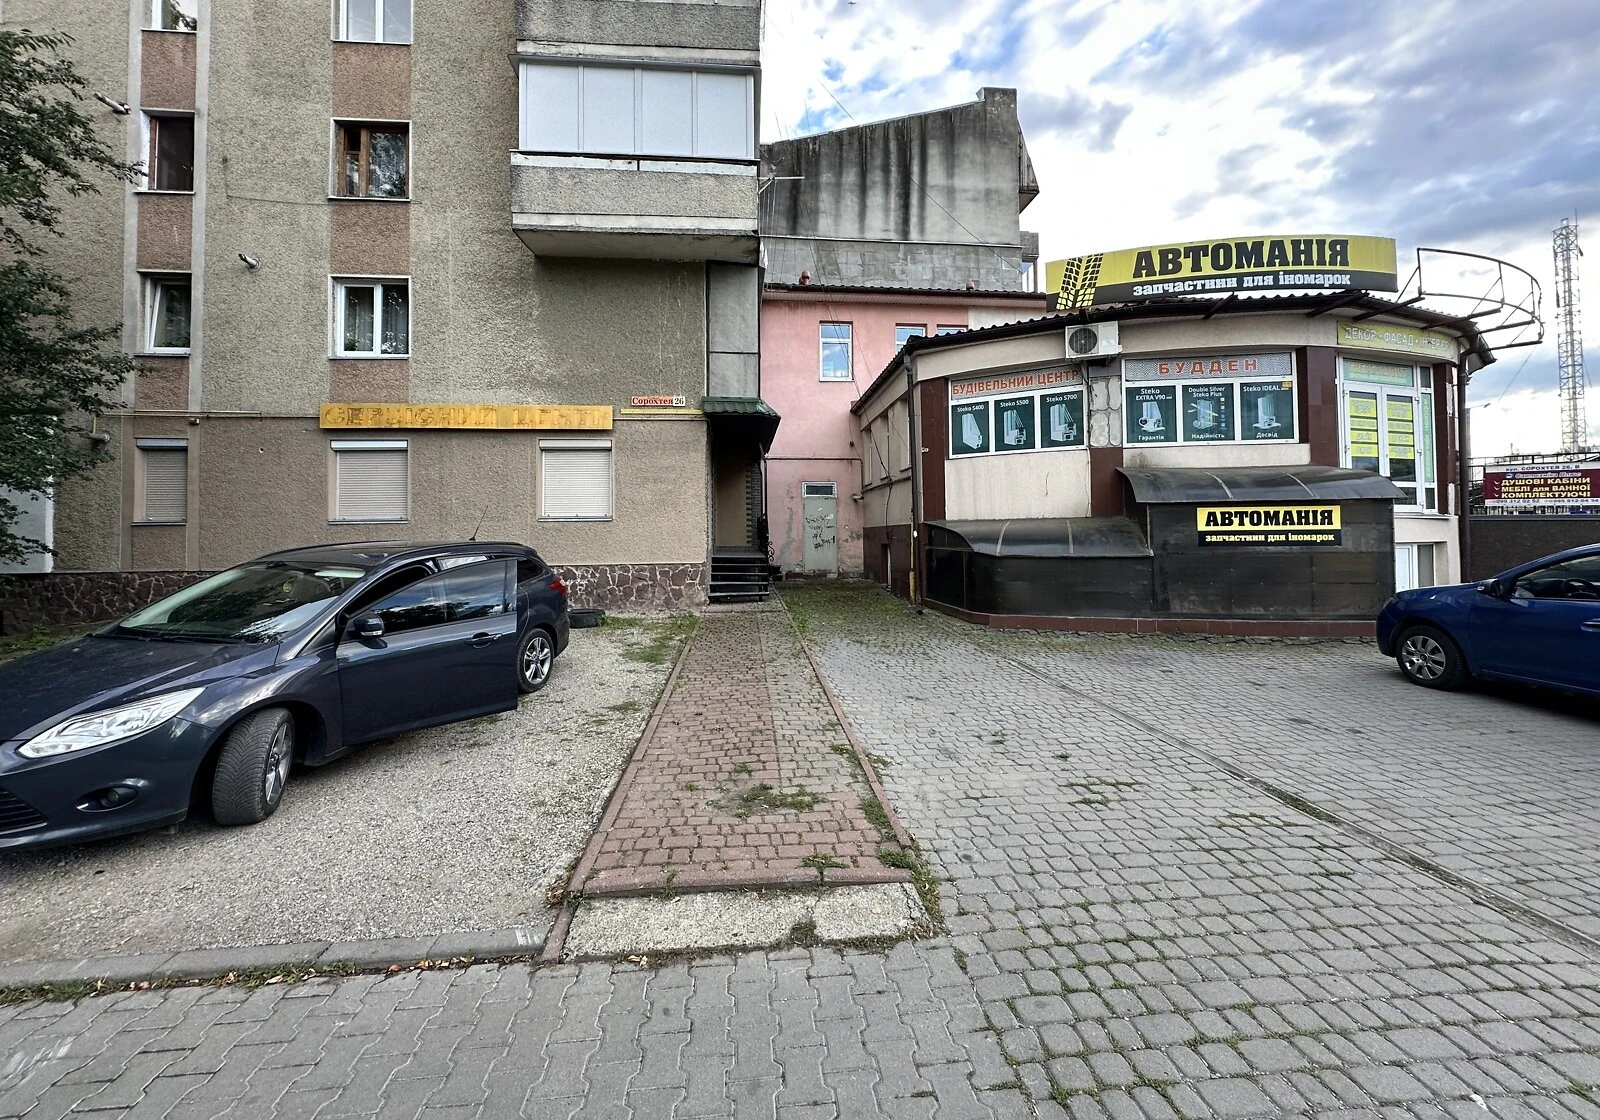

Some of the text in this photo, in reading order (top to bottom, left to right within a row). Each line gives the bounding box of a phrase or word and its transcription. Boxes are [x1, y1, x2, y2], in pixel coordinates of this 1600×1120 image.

[1132, 238, 1350, 279] АВТОМАНІЯ
[1133, 271, 1351, 297] запчастини для іномарок
[1345, 327, 1376, 341] ДЕКОР
[1384, 332, 1414, 347] ФАСАД
[1158, 359, 1258, 375] БУДДЕН
[1037, 369, 1079, 385] ЦЕНТР
[1063, 393, 1077, 401] S700
[1140, 387, 1160, 395] Steko
[674, 397, 685, 405] 26
[1501, 491, 1591, 499] КОМПЛЕКТУЮЧІ
[1205, 510, 1334, 527] АВТОМАНІЯ
[1205, 533, 1335, 542] запчастини для іномарок
